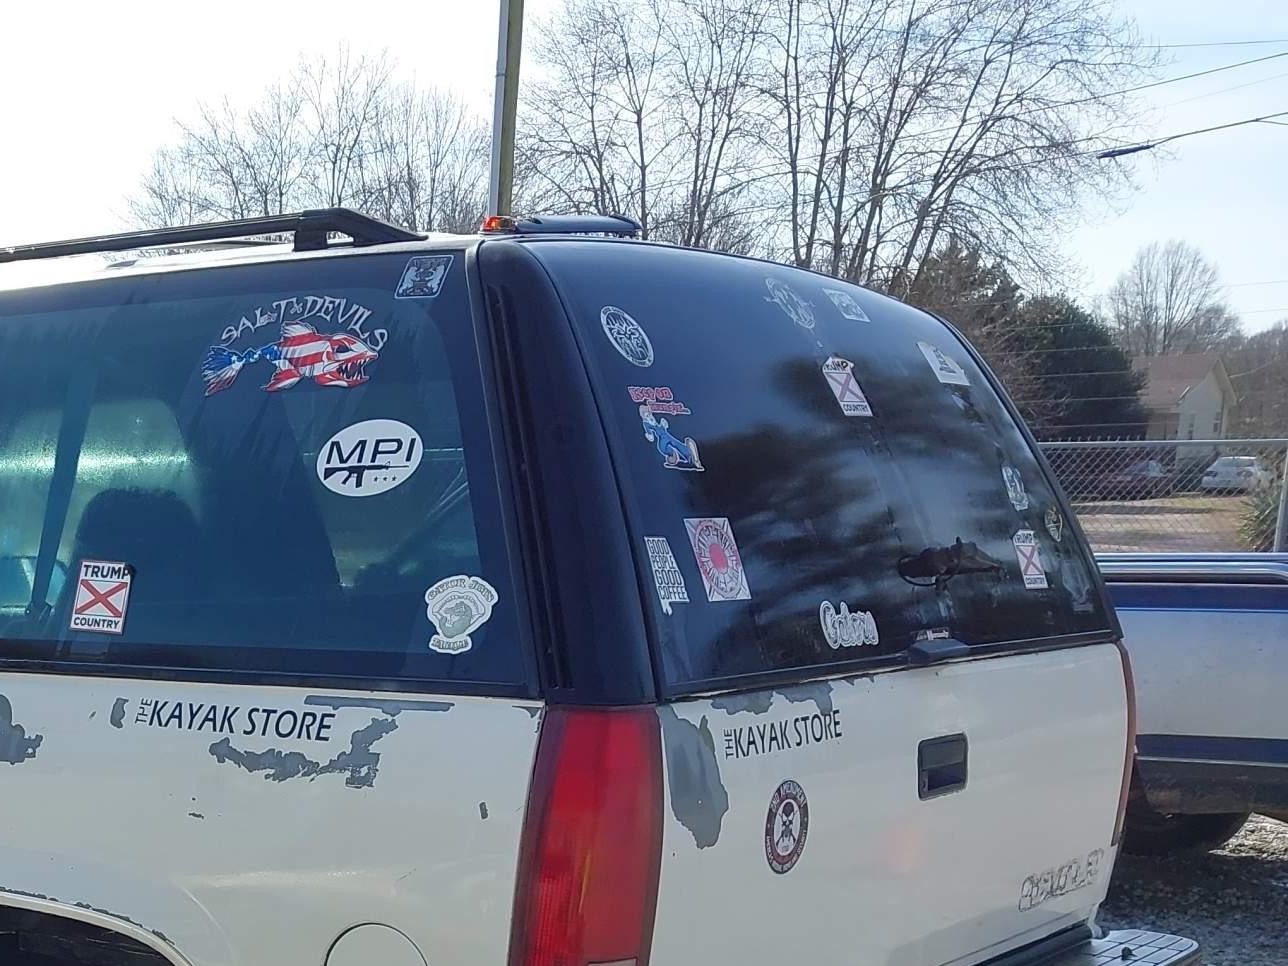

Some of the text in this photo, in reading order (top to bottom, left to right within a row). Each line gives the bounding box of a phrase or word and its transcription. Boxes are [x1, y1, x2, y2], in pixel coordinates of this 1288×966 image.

[297, 296, 388, 351] DEVILS
[326, 438, 417, 464] MPI
[647, 539, 670, 555] GOOD
[651, 555, 676, 570] PEOPLE
[83, 564, 131, 580] TRUMP
[655, 569, 683, 586] GOOD
[658, 585, 688, 600] COFFEE
[73, 616, 120, 629] COUNTRY
[134, 697, 337, 742] THE KAYAK STORE
[723, 709, 843, 760] THE KAYAK STORE
